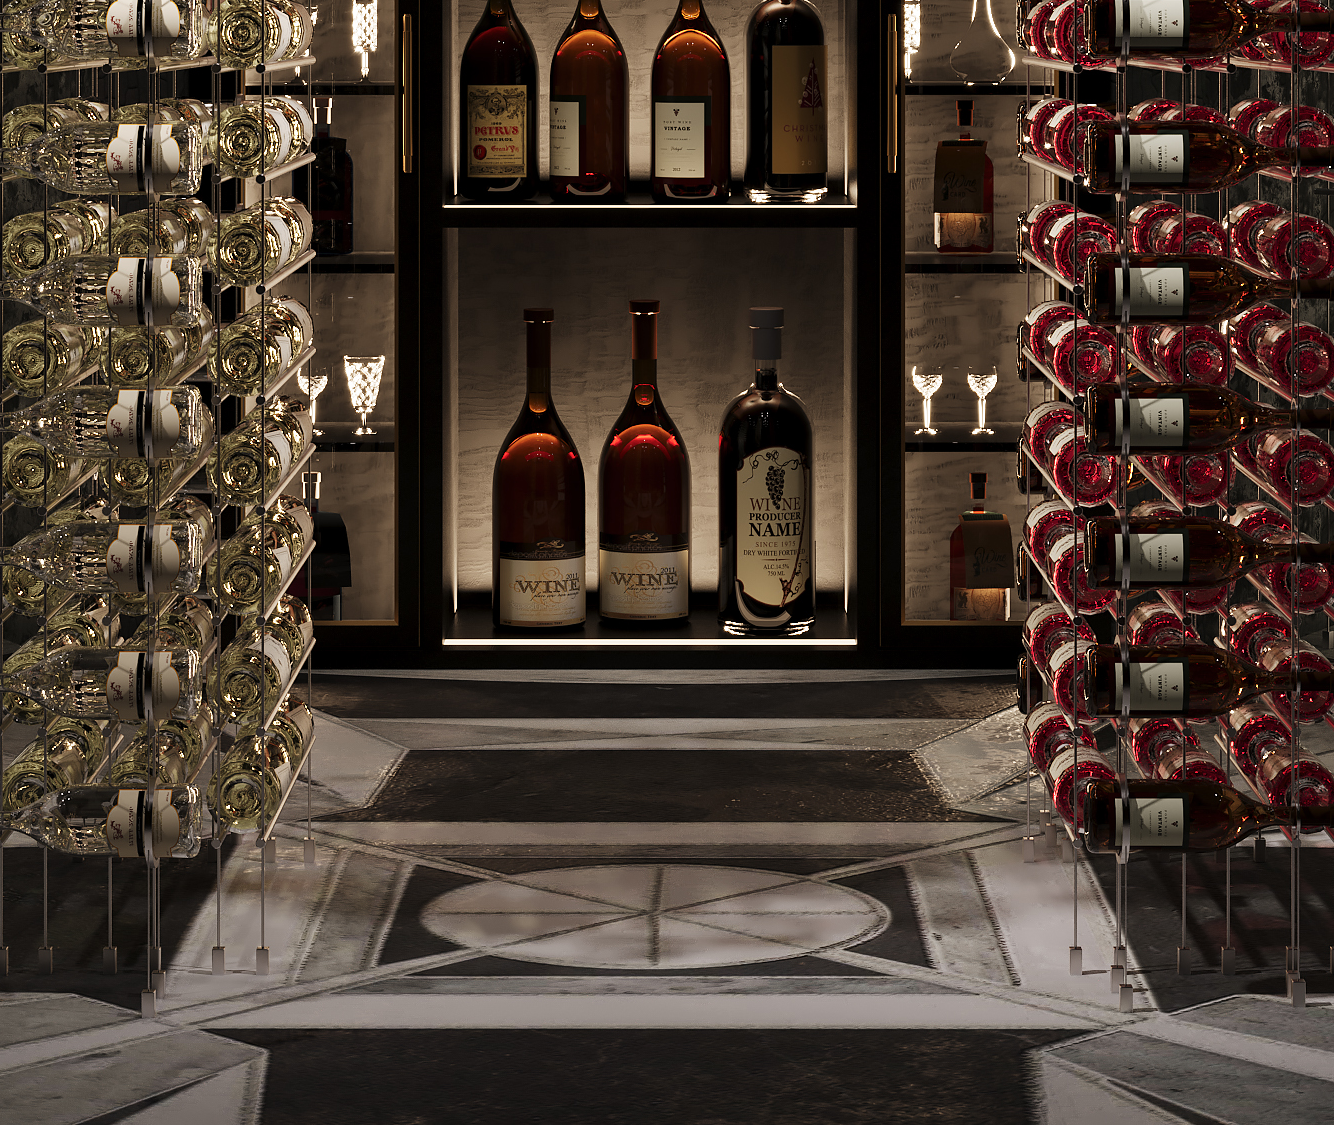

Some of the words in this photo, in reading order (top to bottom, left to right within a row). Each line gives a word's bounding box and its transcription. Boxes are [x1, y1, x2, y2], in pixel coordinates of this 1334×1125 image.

[943, 171, 977, 193] Wine
[750, 497, 801, 512] WINE
[749, 511, 801, 522] PRODUCER
[749, 522, 801, 537] NAME
[974, 546, 1007, 565] Wine
[515, 578, 581, 594] WINE
[611, 572, 679, 587] WINE
